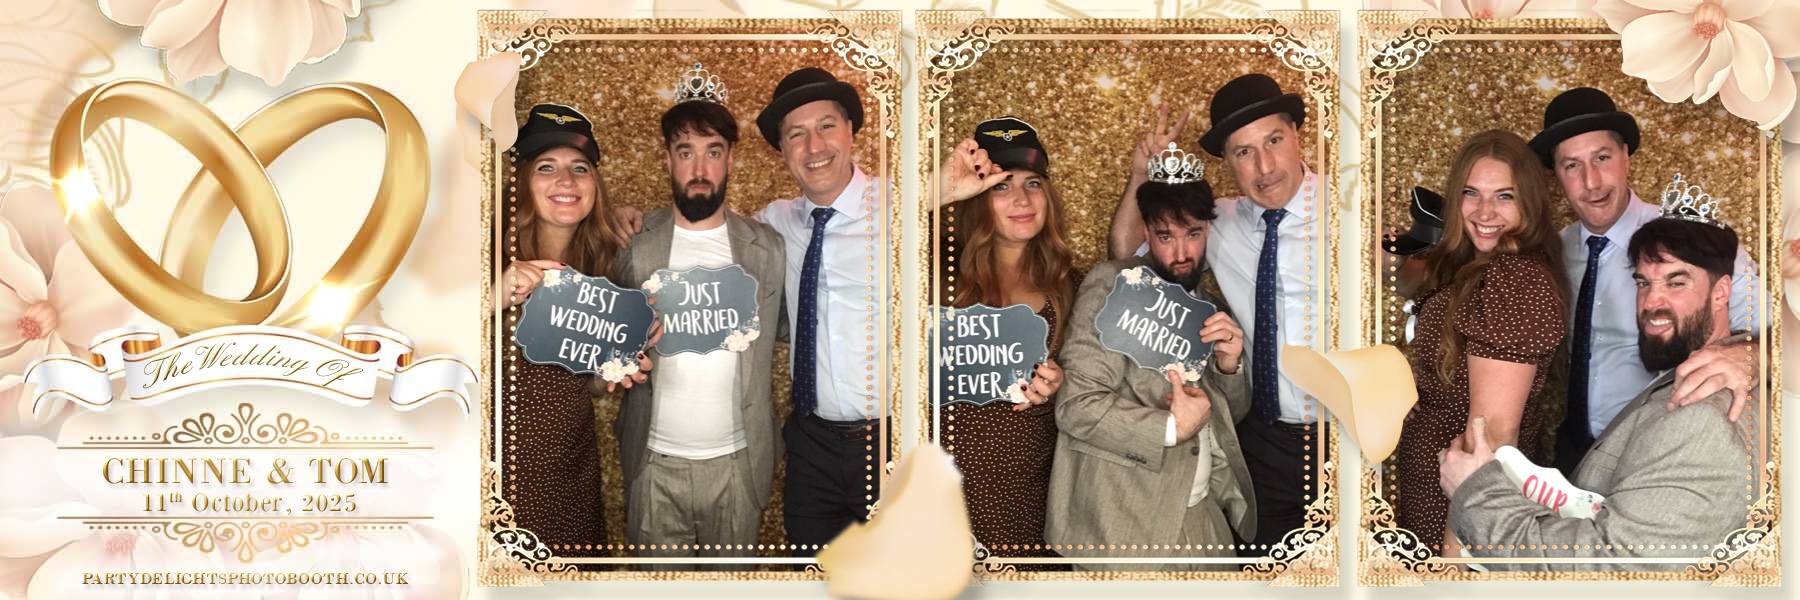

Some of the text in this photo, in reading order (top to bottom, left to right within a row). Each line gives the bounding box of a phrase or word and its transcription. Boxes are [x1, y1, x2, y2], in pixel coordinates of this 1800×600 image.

[576, 281, 620, 314] BEST
[678, 281, 721, 306] JUST
[1144, 288, 1192, 330] JUST
[550, 304, 628, 344] WEDDING
[663, 308, 739, 336] MARRIED
[957, 313, 1001, 340] BEST
[1116, 309, 1192, 361] MARRIED
[558, 338, 603, 371] EVER
[939, 342, 1024, 367] WEDDING
[958, 371, 1004, 398] EVER
[1522, 474, 1569, 515] OUR
